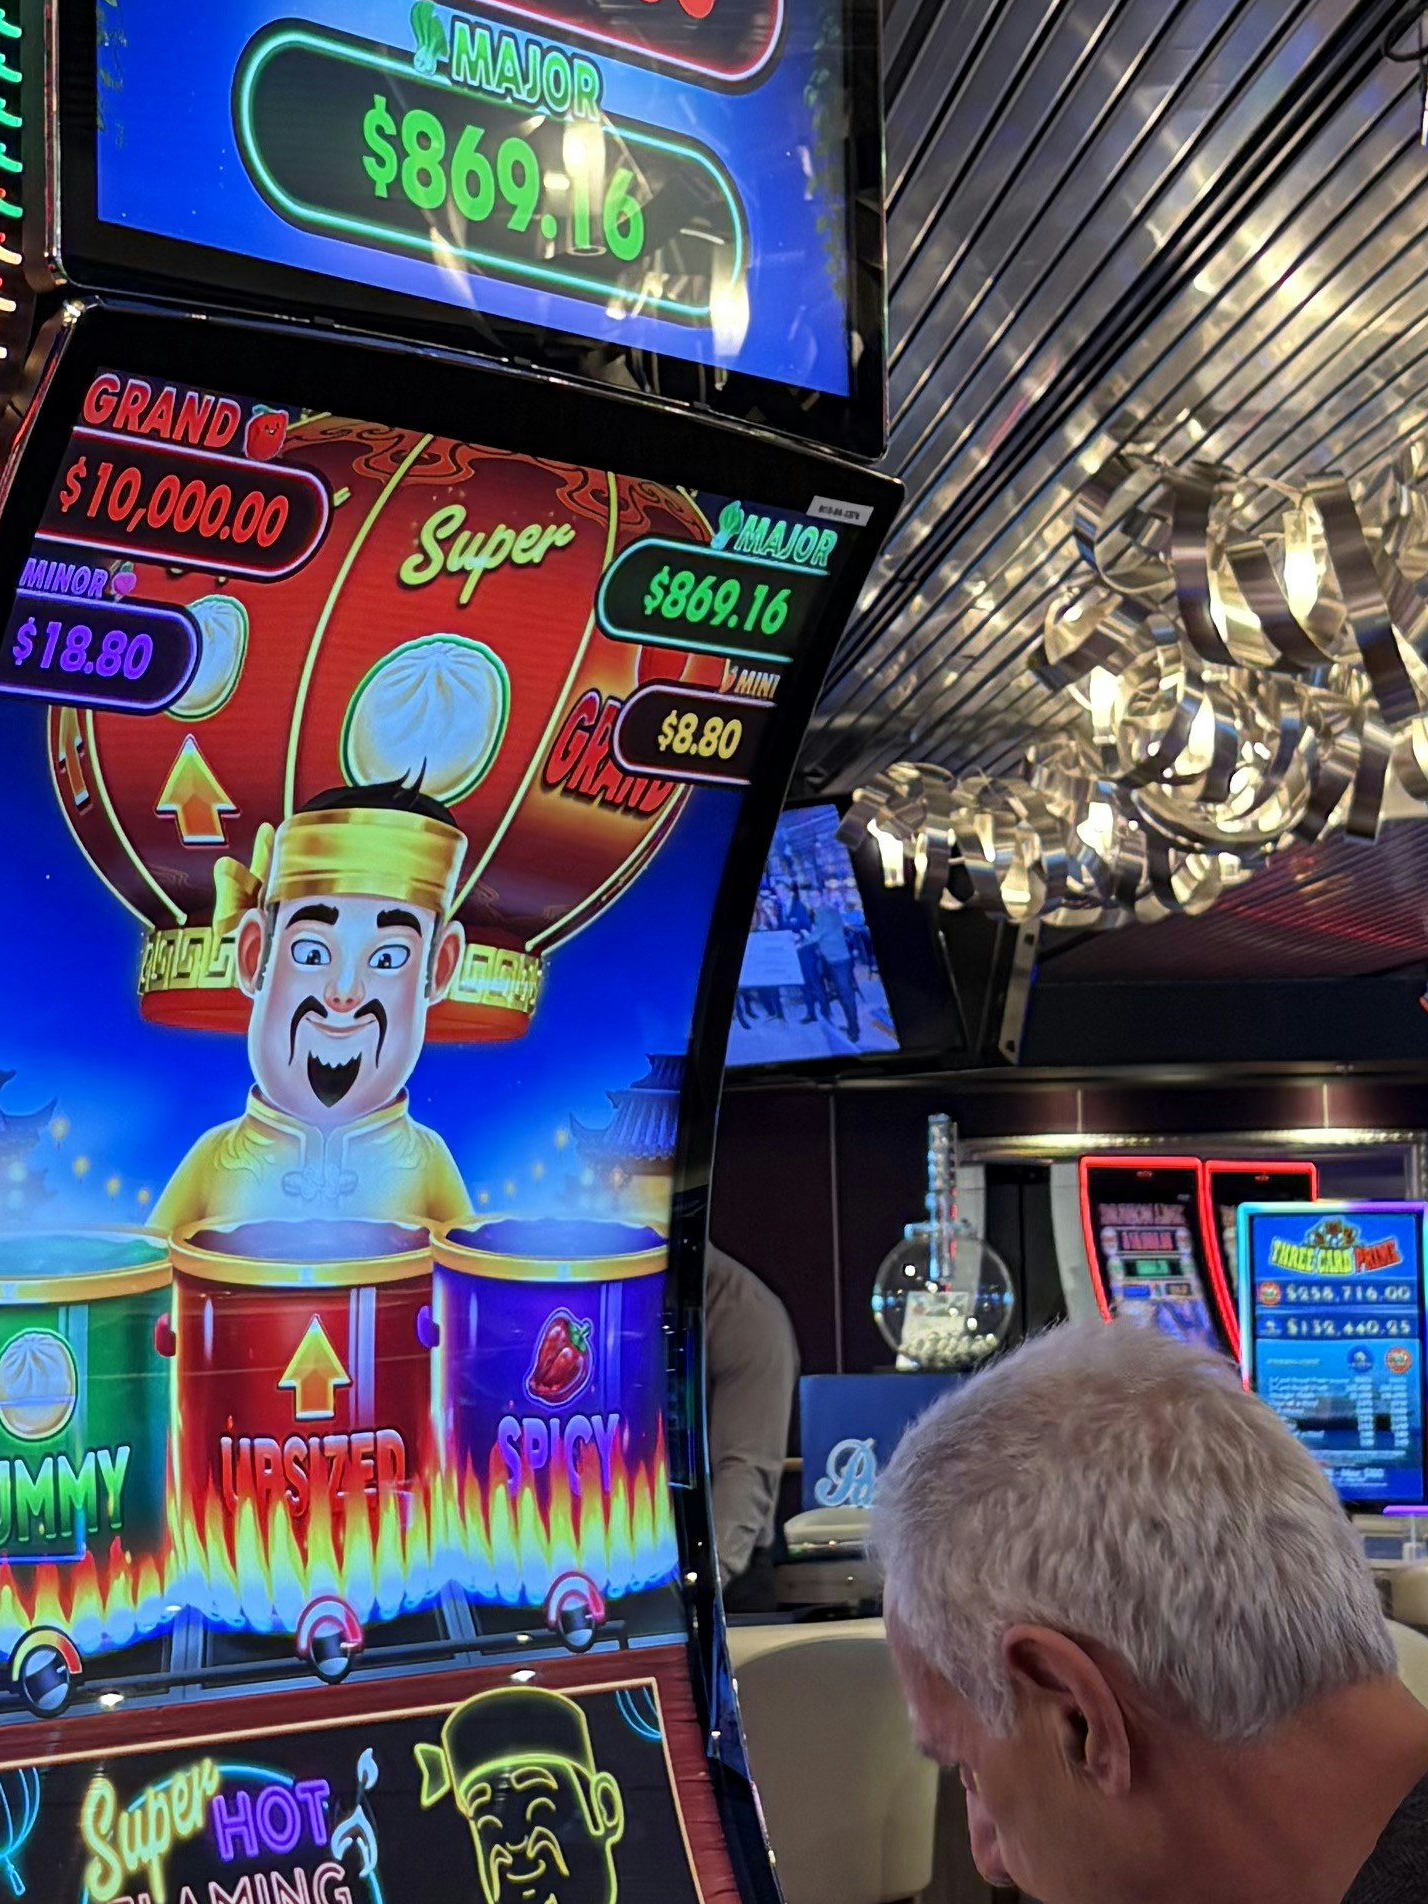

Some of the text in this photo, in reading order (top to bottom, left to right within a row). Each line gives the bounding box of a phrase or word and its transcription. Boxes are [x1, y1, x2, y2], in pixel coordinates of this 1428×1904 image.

[450, 16, 604, 122] MAJOR
[361, 96, 646, 262] $869.16
[82, 372, 242, 448] GRAND
[59, 455, 289, 548] $10,000.00
[18, 557, 109, 599] MINOR
[399, 503, 576, 605] Super
[733, 513, 839, 568] MAJOR
[643, 565, 792, 636] $869.16
[12, 616, 154, 680] $18.80
[657, 710, 743, 760] $8.80
[1270, 1238, 1315, 1273] THREE
[1315, 1248, 1353, 1276] CARD
[497, 1413, 621, 1497] SPICY
[212, 1778, 332, 1863] HOT
